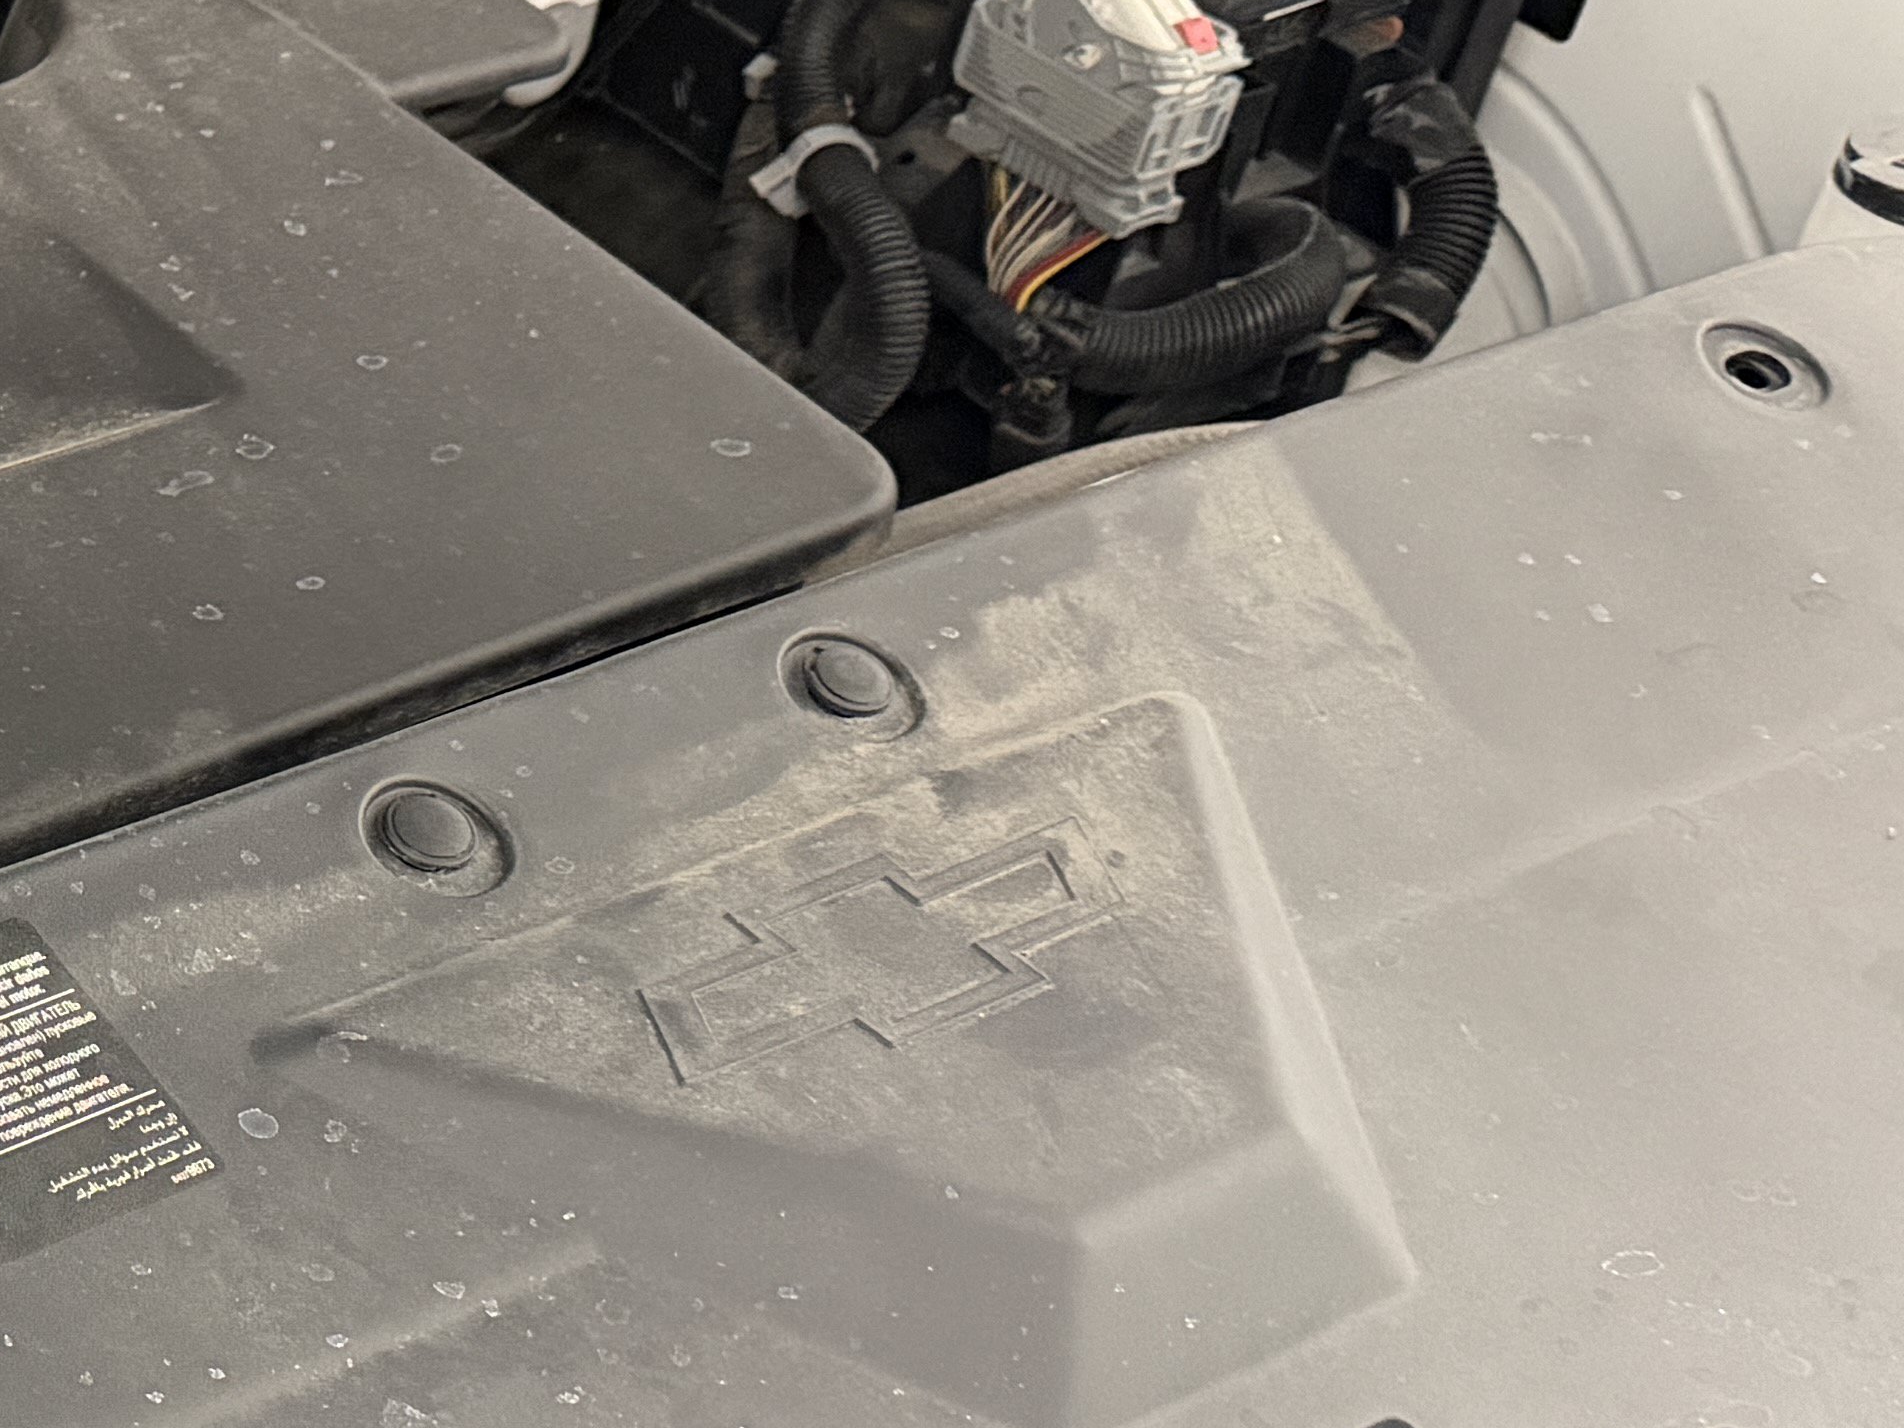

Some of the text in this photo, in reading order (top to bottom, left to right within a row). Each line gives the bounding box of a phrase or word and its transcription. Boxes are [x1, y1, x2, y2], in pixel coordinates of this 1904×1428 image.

[7, 982, 46, 1004] motor.
[8, 998, 82, 1036] ДВИГАТЕЛЬ
[42, 1010, 98, 1039] пусковые
[19, 1065, 44, 1082] для
[40, 1042, 101, 1073] холодного
[42, 1067, 81, 1089] может
[33, 1073, 110, 1110] немедленное
[71, 1082, 134, 1114] двигателя.
